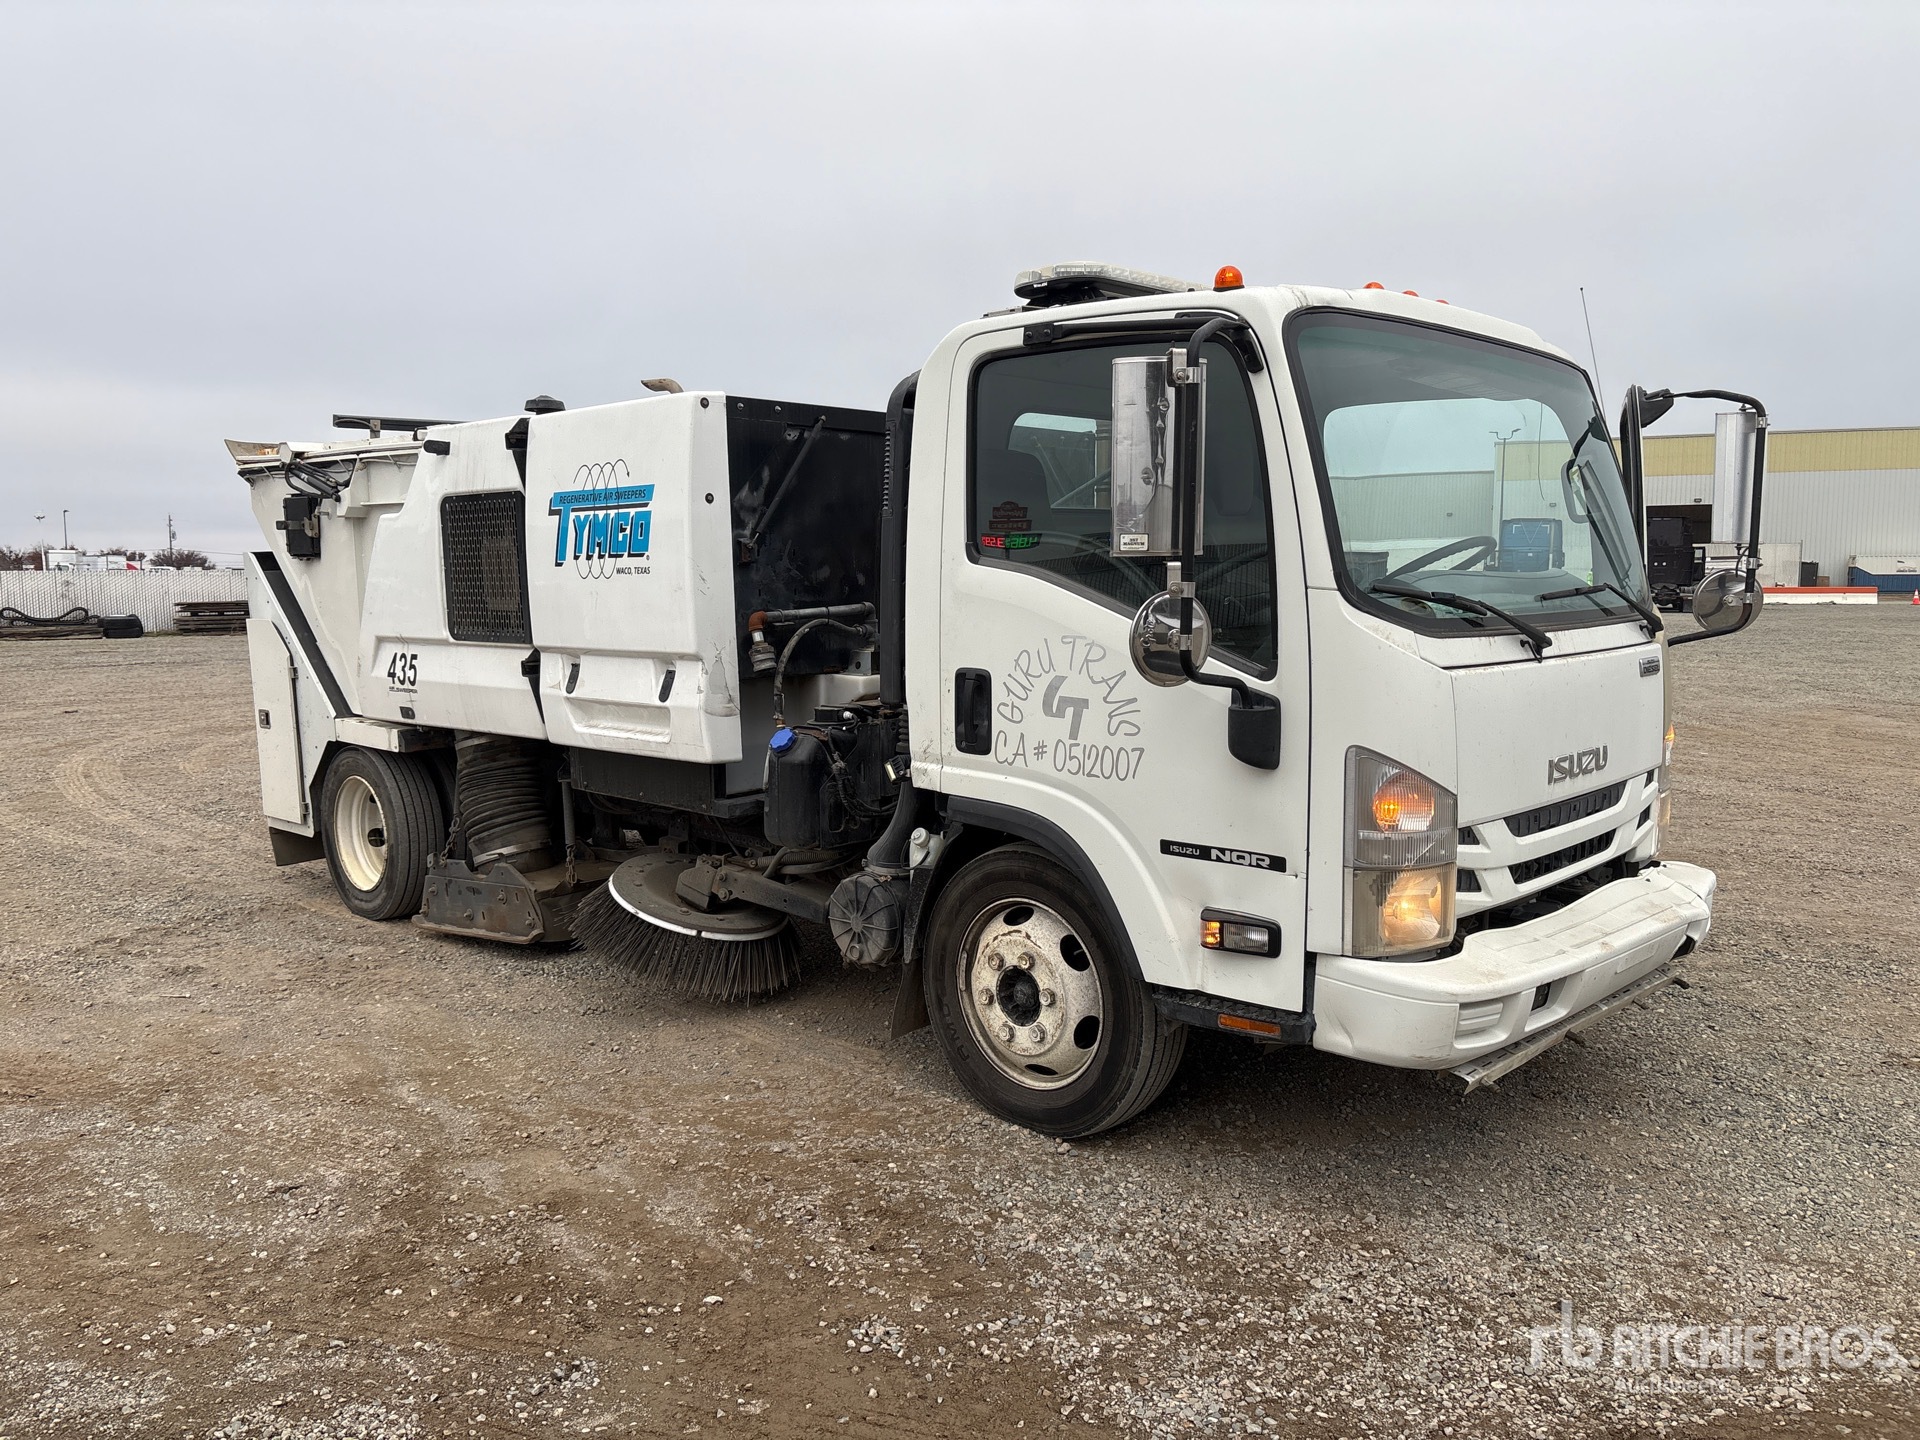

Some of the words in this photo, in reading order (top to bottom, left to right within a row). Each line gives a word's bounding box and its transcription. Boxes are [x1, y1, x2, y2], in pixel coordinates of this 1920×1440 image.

[559, 492, 602, 504] REGENERATIVE
[603, 492, 614, 501] AIR
[614, 489, 647, 501] SWEEPERS
[616, 567, 633, 576] WACO,
[634, 566, 651, 575] TEXAS
[387, 652, 418, 687] 435
[997, 638, 1056, 724] GURU
[1061, 634, 1141, 737] TRANS
[994, 730, 1028, 767] CA
[1033, 739, 1048, 761] #
[1053, 739, 1145, 781] 0512007
[1547, 744, 1609, 785] ISUZU
[1169, 844, 1200, 856] ISUZU
[1210, 848, 1271, 869] NQR
